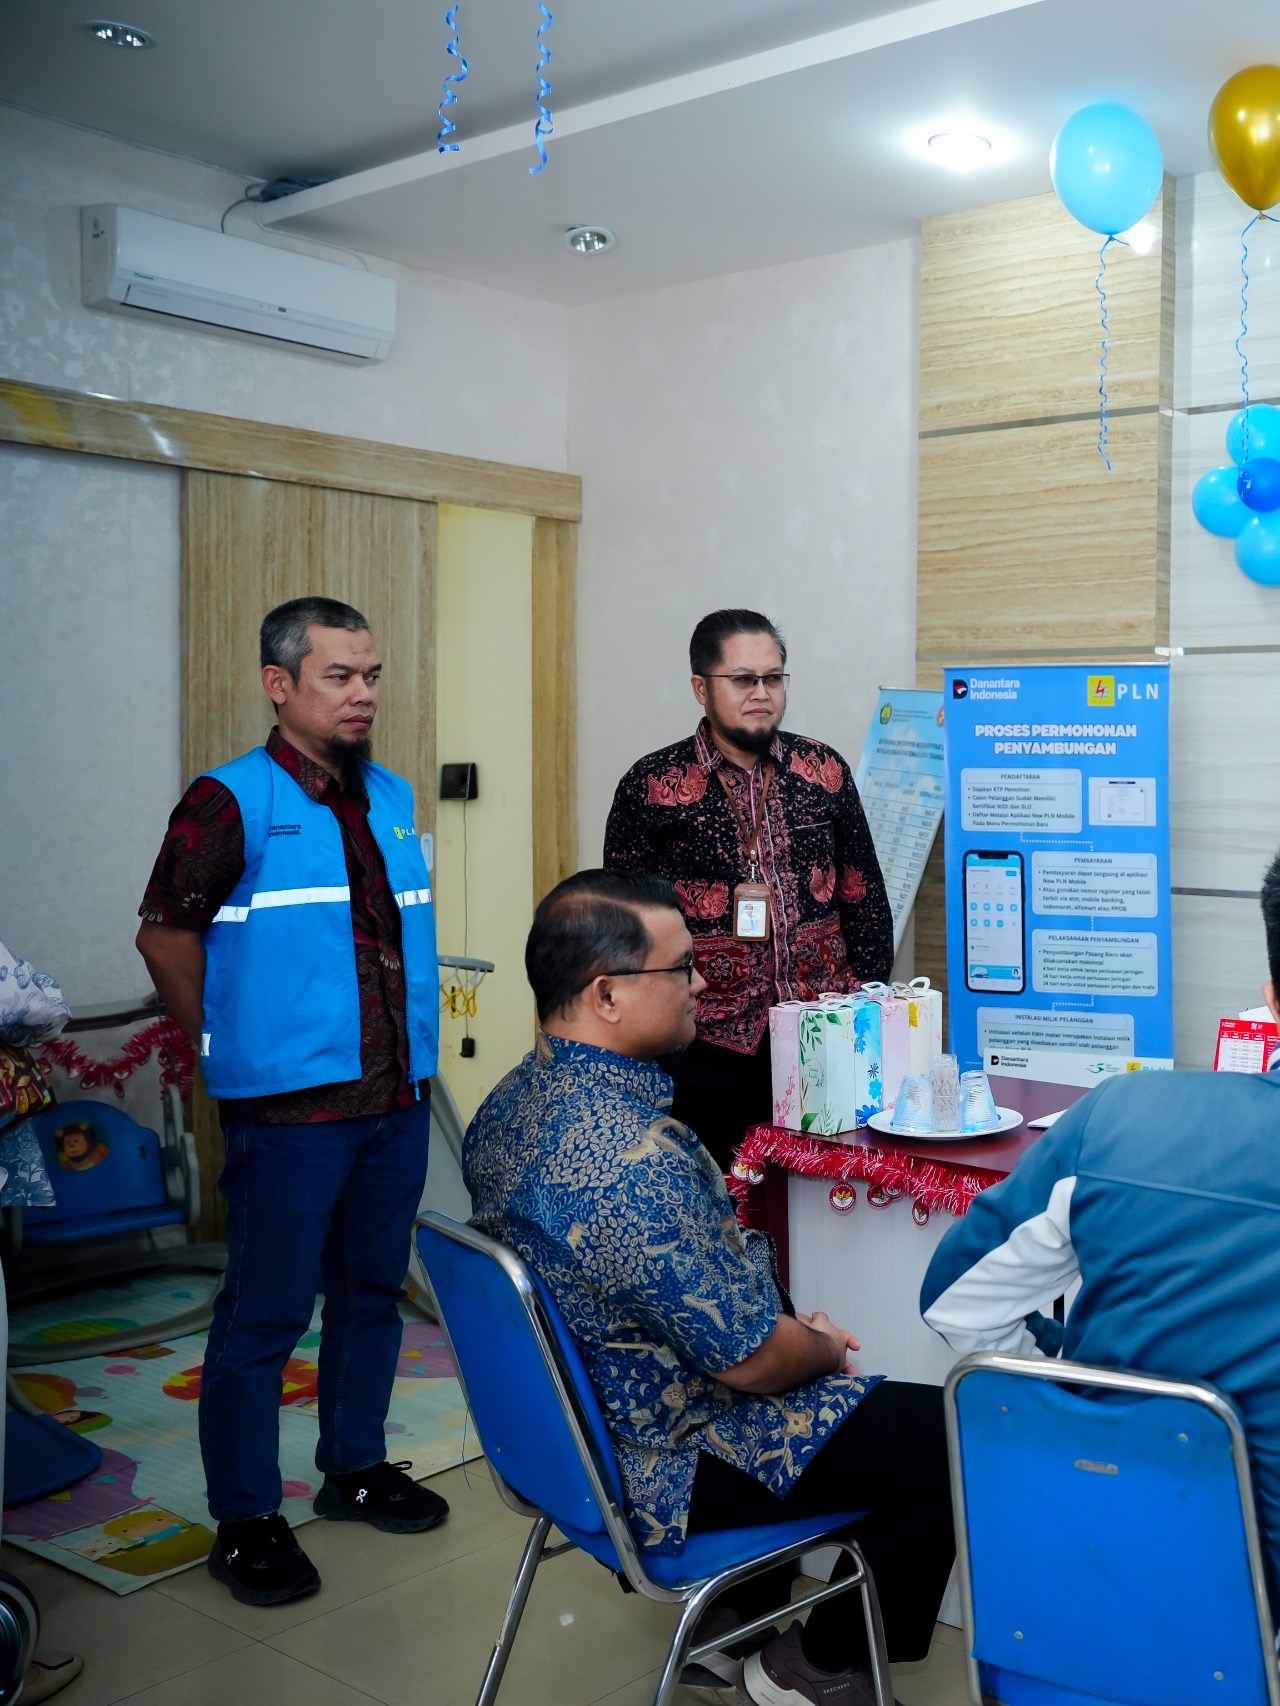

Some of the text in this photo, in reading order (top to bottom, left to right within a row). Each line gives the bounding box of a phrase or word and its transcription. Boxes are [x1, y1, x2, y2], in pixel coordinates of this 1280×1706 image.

[970, 678, 1020, 688] Danantara
[970, 690, 1017, 699] Indonesia
[1117, 684, 1159, 699] PLN
[975, 724, 1137, 737] PROSES PERMOHONAN
[994, 742, 1116, 755] PENYAMBUNGAN
